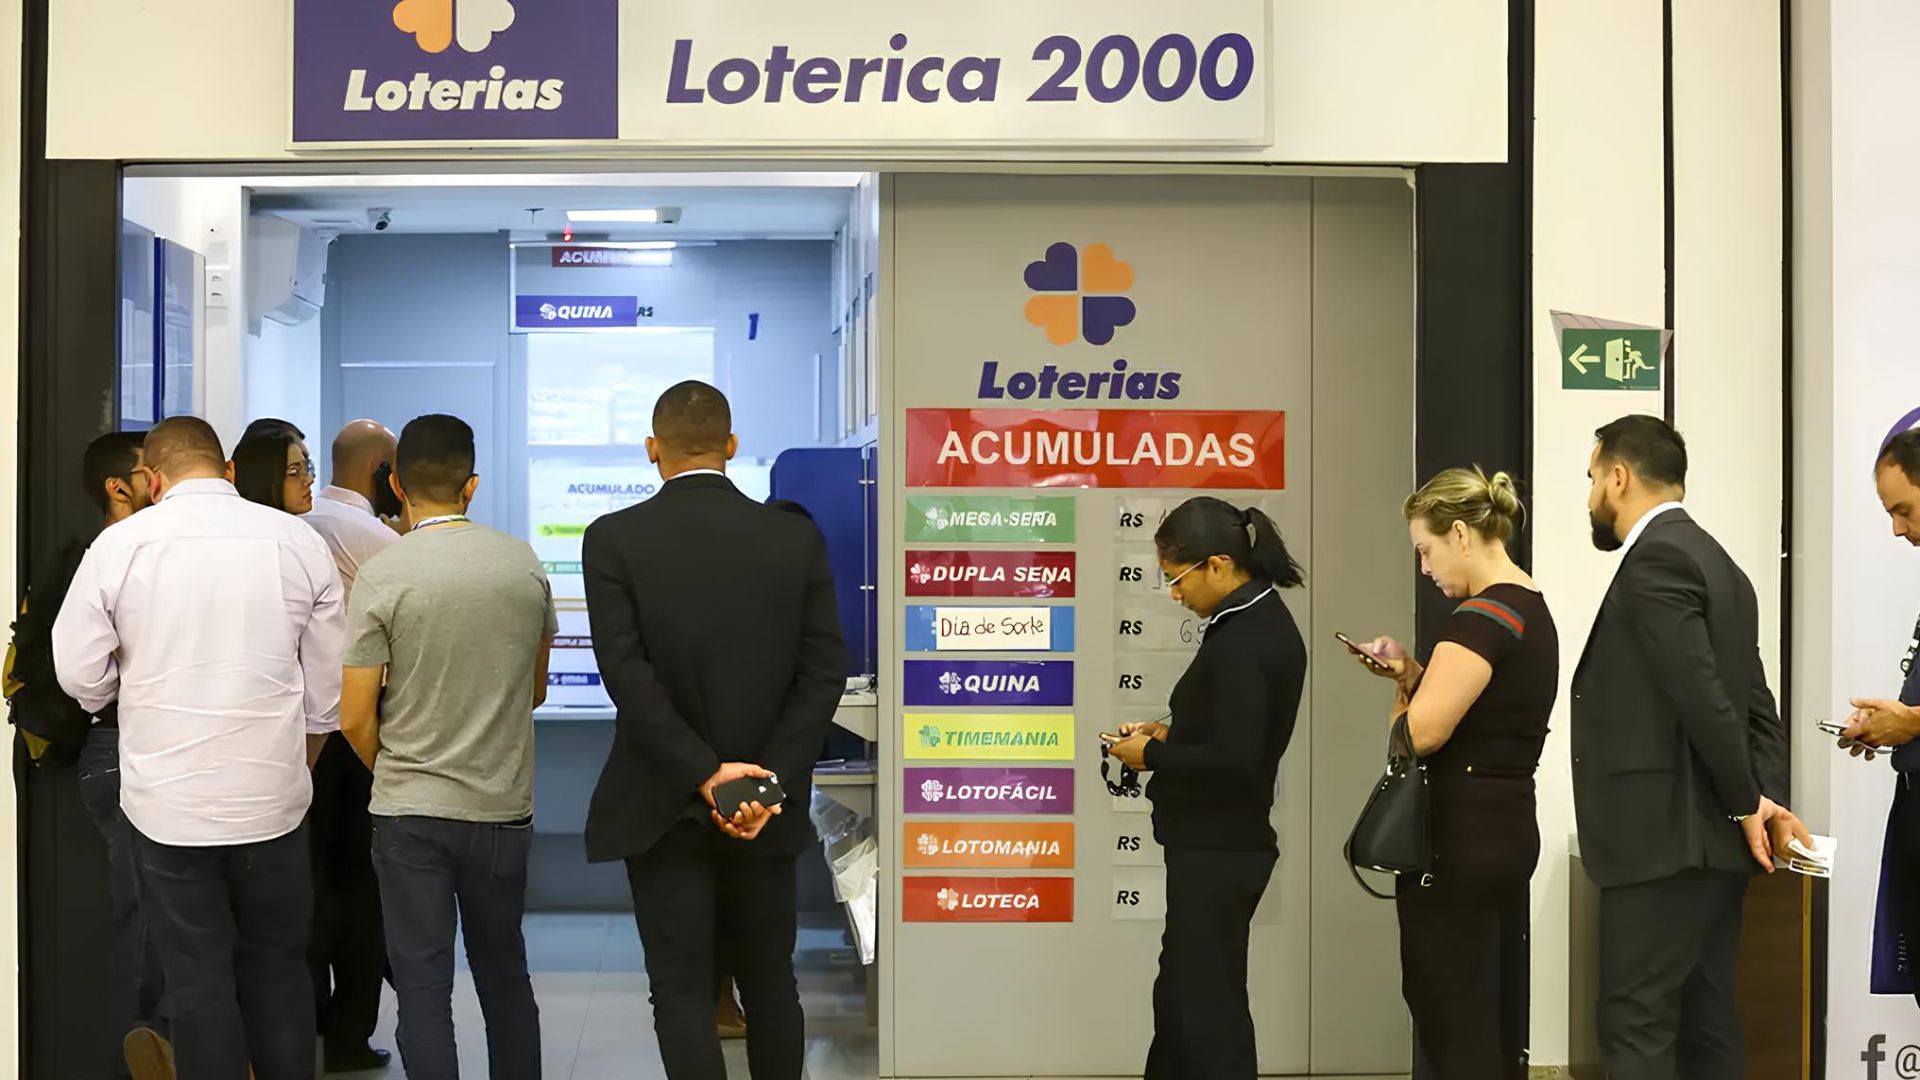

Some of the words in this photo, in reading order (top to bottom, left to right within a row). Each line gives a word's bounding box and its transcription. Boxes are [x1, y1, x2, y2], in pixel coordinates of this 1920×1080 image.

[665, 32, 1001, 105] Loterica
[1026, 32, 1255, 103] 2000
[343, 65, 564, 111] Loterias
[557, 305, 613, 320] QUINA
[977, 358, 1182, 401] Loterias
[936, 430, 1256, 467] ACUMULADAS
[567, 484, 656, 495] ACUMULADO
[949, 510, 1058, 528] MEGA-SENA
[932, 565, 1007, 583] DUPLA
[1013, 565, 1073, 585] SENA
[941, 616, 971, 638] Dia
[974, 616, 996, 635] de
[1000, 615, 1045, 636] Sorte
[964, 674, 1041, 695] QUINA
[944, 730, 1060, 747] TIMEMANIA
[946, 781, 1058, 801] LOTOFÁCIL
[942, 839, 1061, 857] LOTOMANIA
[961, 893, 1041, 910] LOTECA
